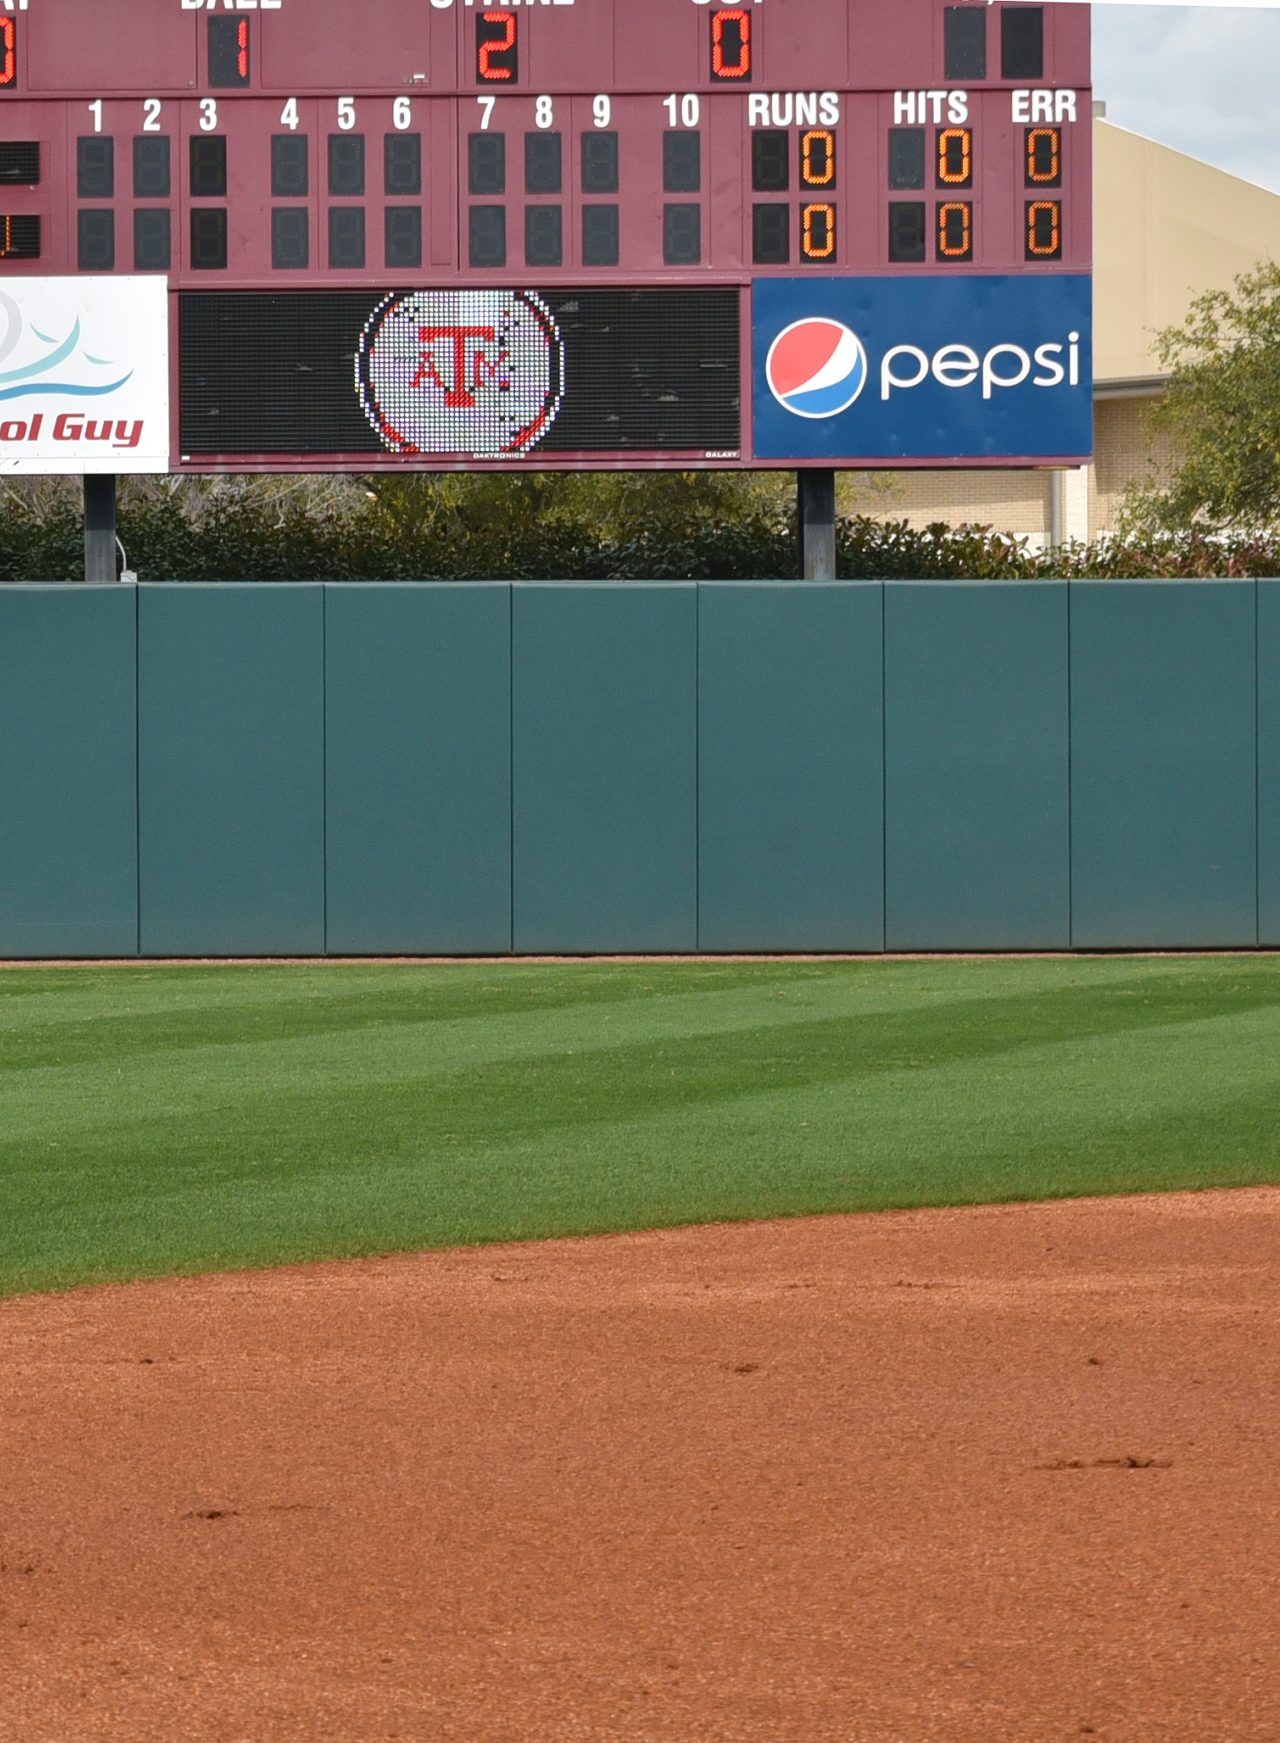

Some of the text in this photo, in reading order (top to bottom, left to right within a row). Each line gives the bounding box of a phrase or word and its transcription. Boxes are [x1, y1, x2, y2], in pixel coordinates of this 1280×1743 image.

[237, 20, 248, 79] 1
[478, 11, 516, 79] 2
[712, 9, 750, 77] 0
[88, 89, 1077, 132] 1 2 3 4 5 6 7 8 9 10 RUNS HITS ERR
[802, 129, 834, 185] 0
[938, 128, 970, 183] 0
[1027, 128, 1059, 182] 0
[802, 203, 834, 258] 0
[938, 202, 970, 256] 0
[1028, 201, 1059, 254] 0
[880, 331, 1080, 400] pepsi
[52, 413, 144, 449] Guy
